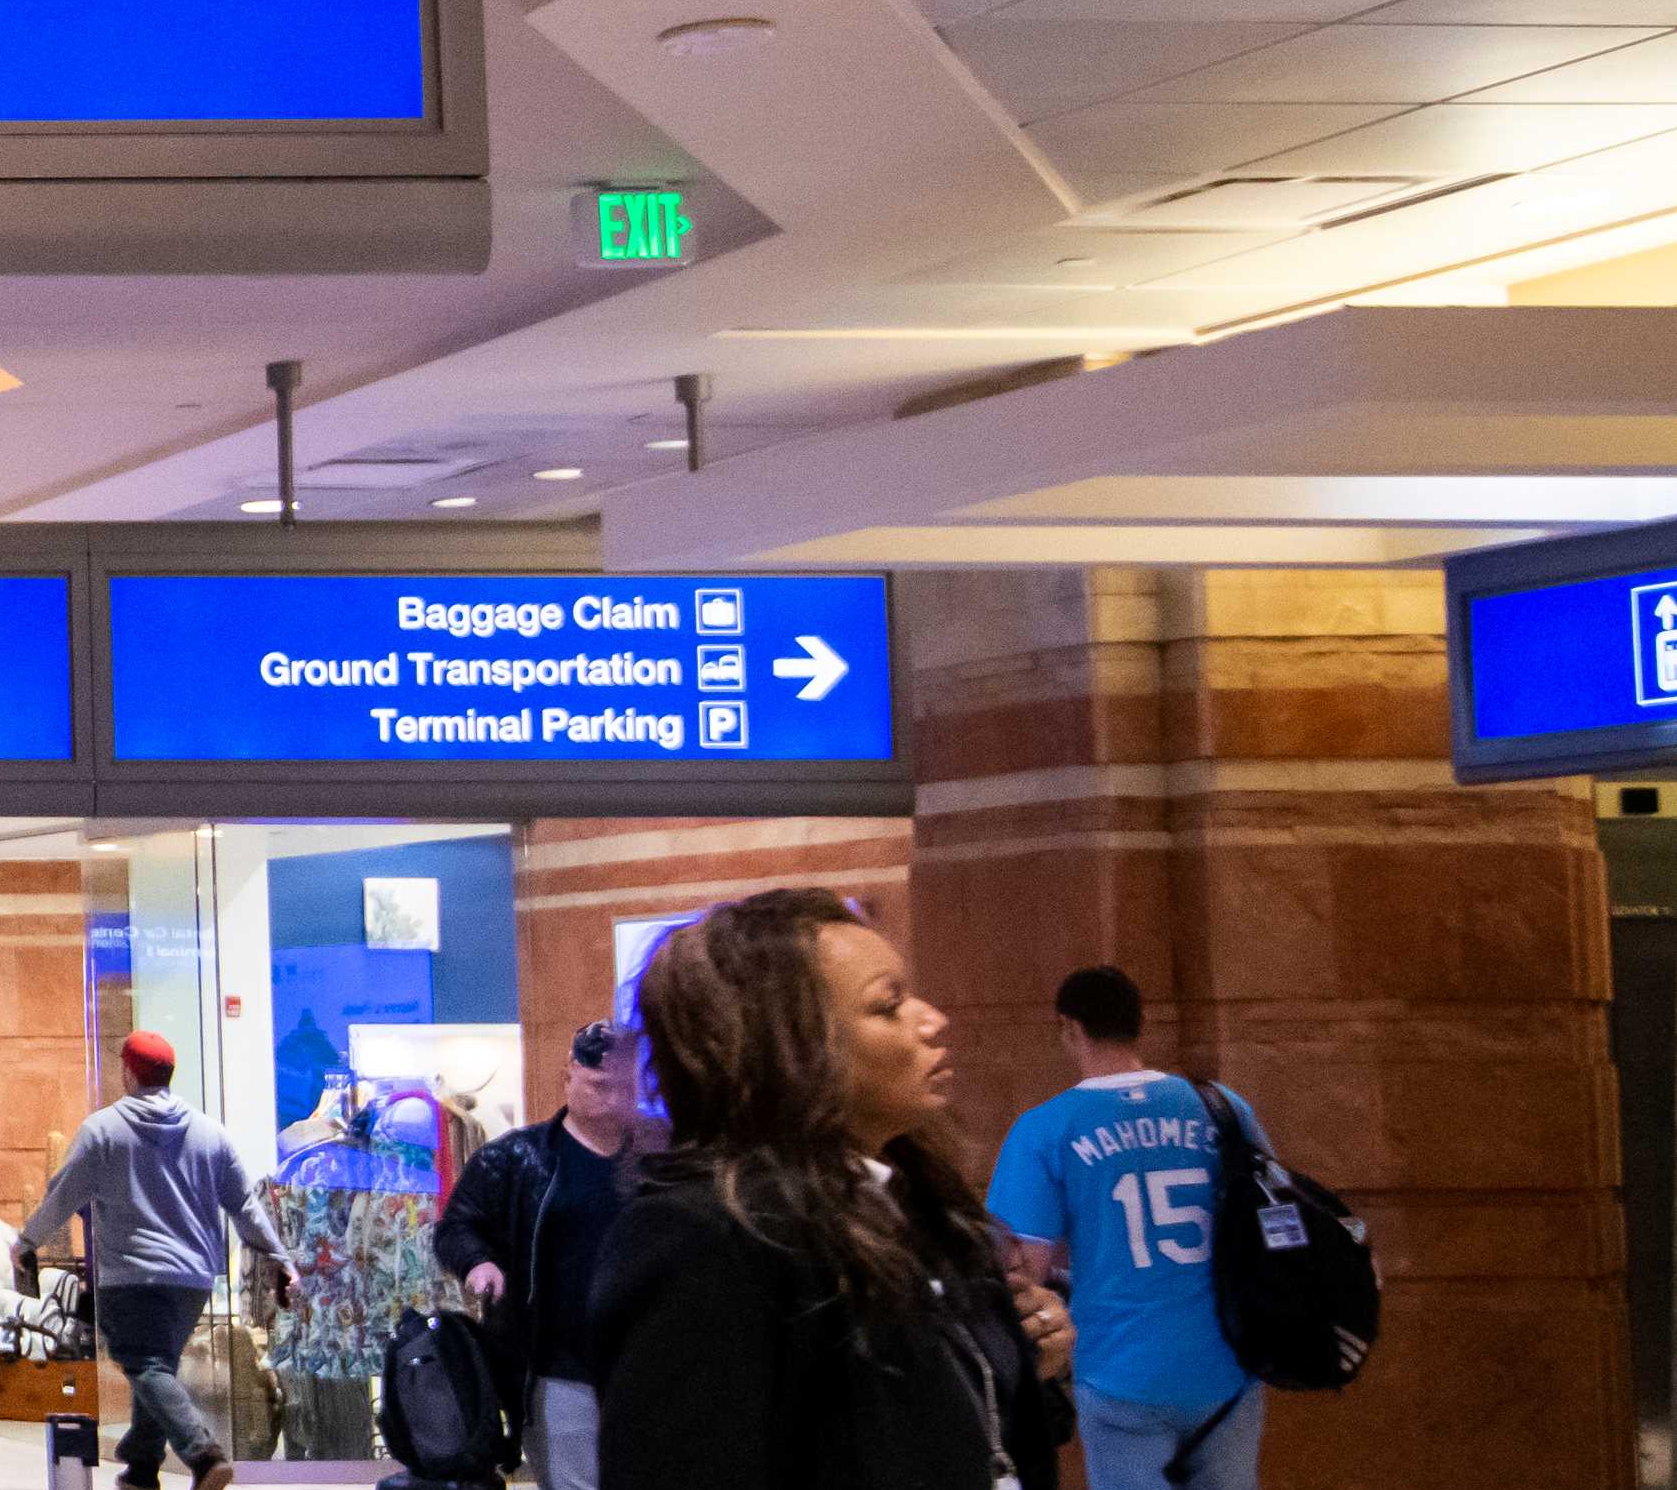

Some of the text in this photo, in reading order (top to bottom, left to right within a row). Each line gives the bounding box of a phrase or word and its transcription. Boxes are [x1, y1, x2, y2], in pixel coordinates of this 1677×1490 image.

[598, 193, 681, 259] EXIT
[398, 595, 680, 637] Baggage Claim
[260, 652, 682, 692] Ground Transportation
[370, 708, 532, 742] Terminal
[542, 708, 685, 750] Parking
[1112, 1167, 1211, 1269] 15
